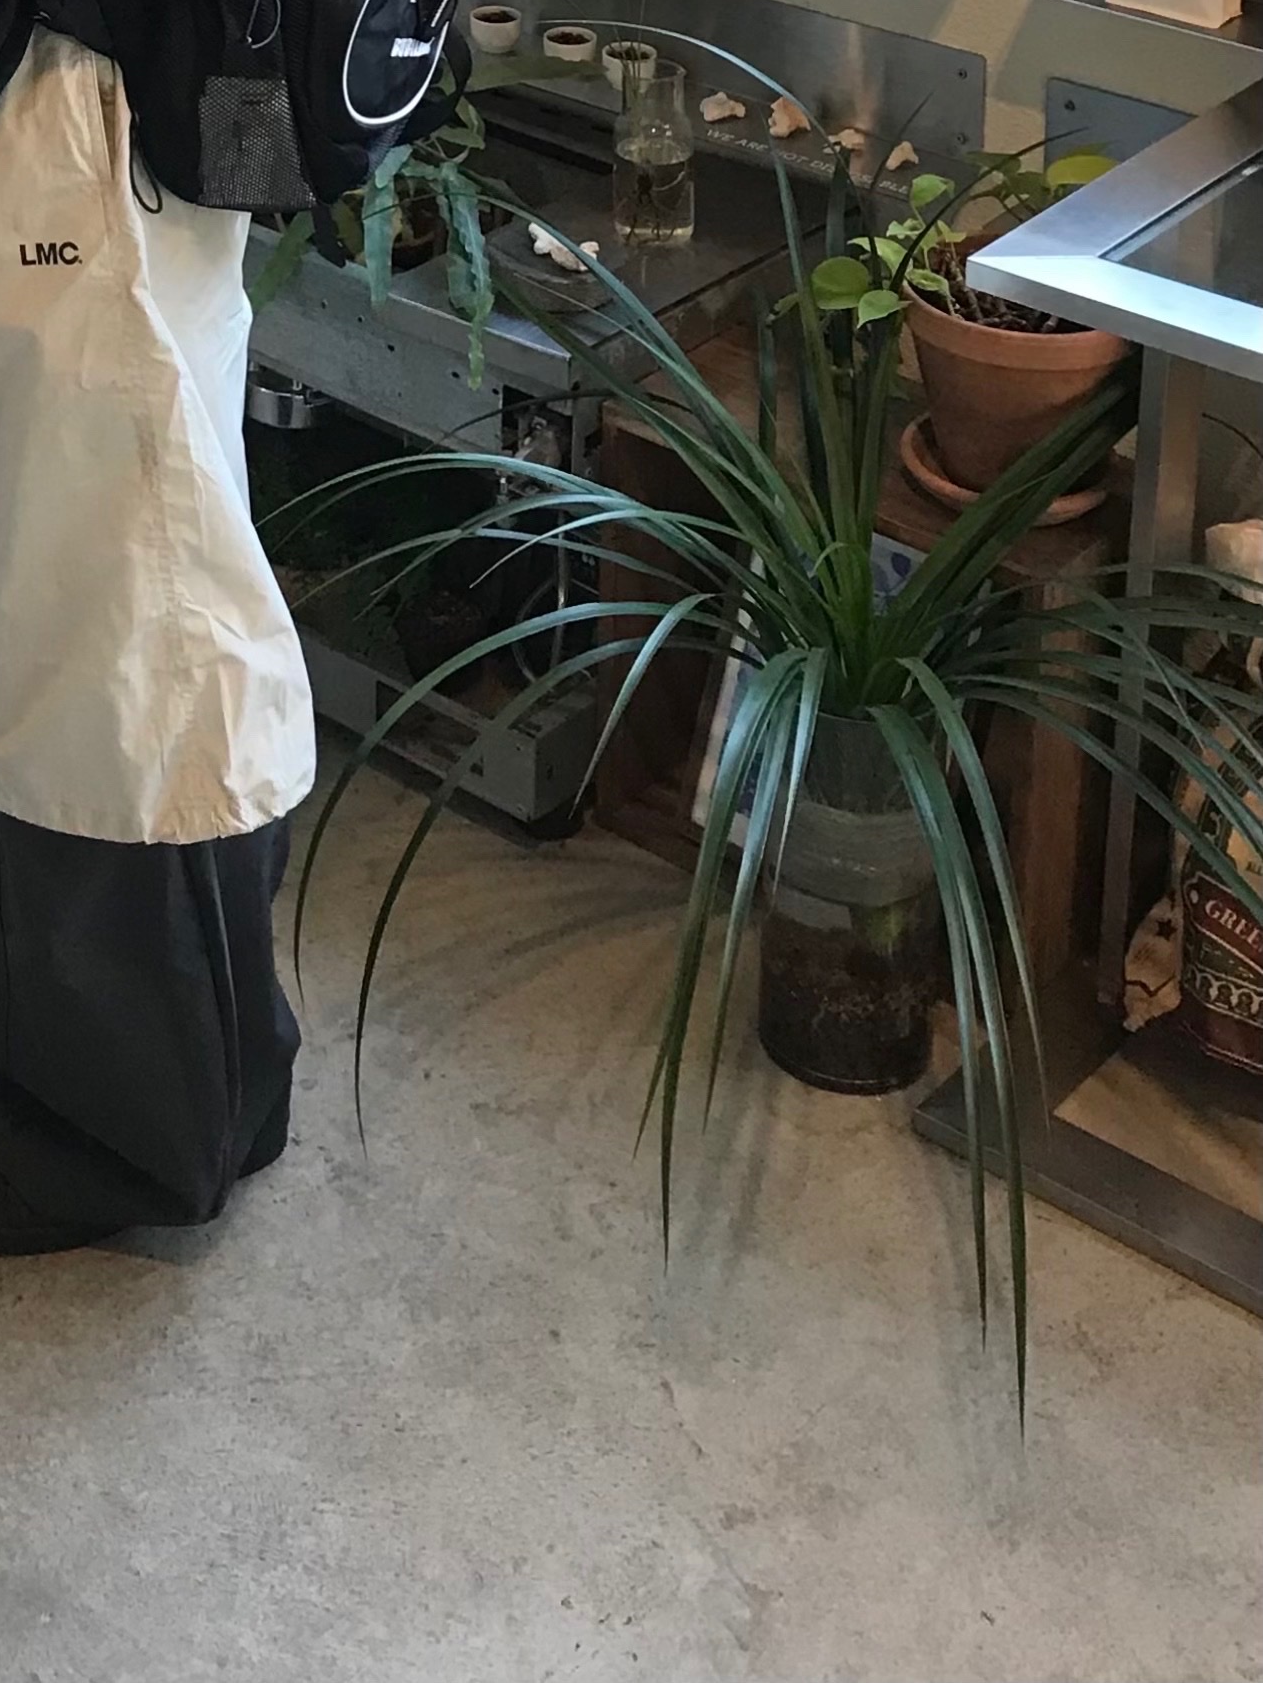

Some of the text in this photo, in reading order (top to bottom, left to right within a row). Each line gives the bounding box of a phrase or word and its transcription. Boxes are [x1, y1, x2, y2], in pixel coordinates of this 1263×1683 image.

[706, 129, 736, 142] WE
[735, 138, 769, 152] ARE
[1204, 899, 1263, 953] GREE
